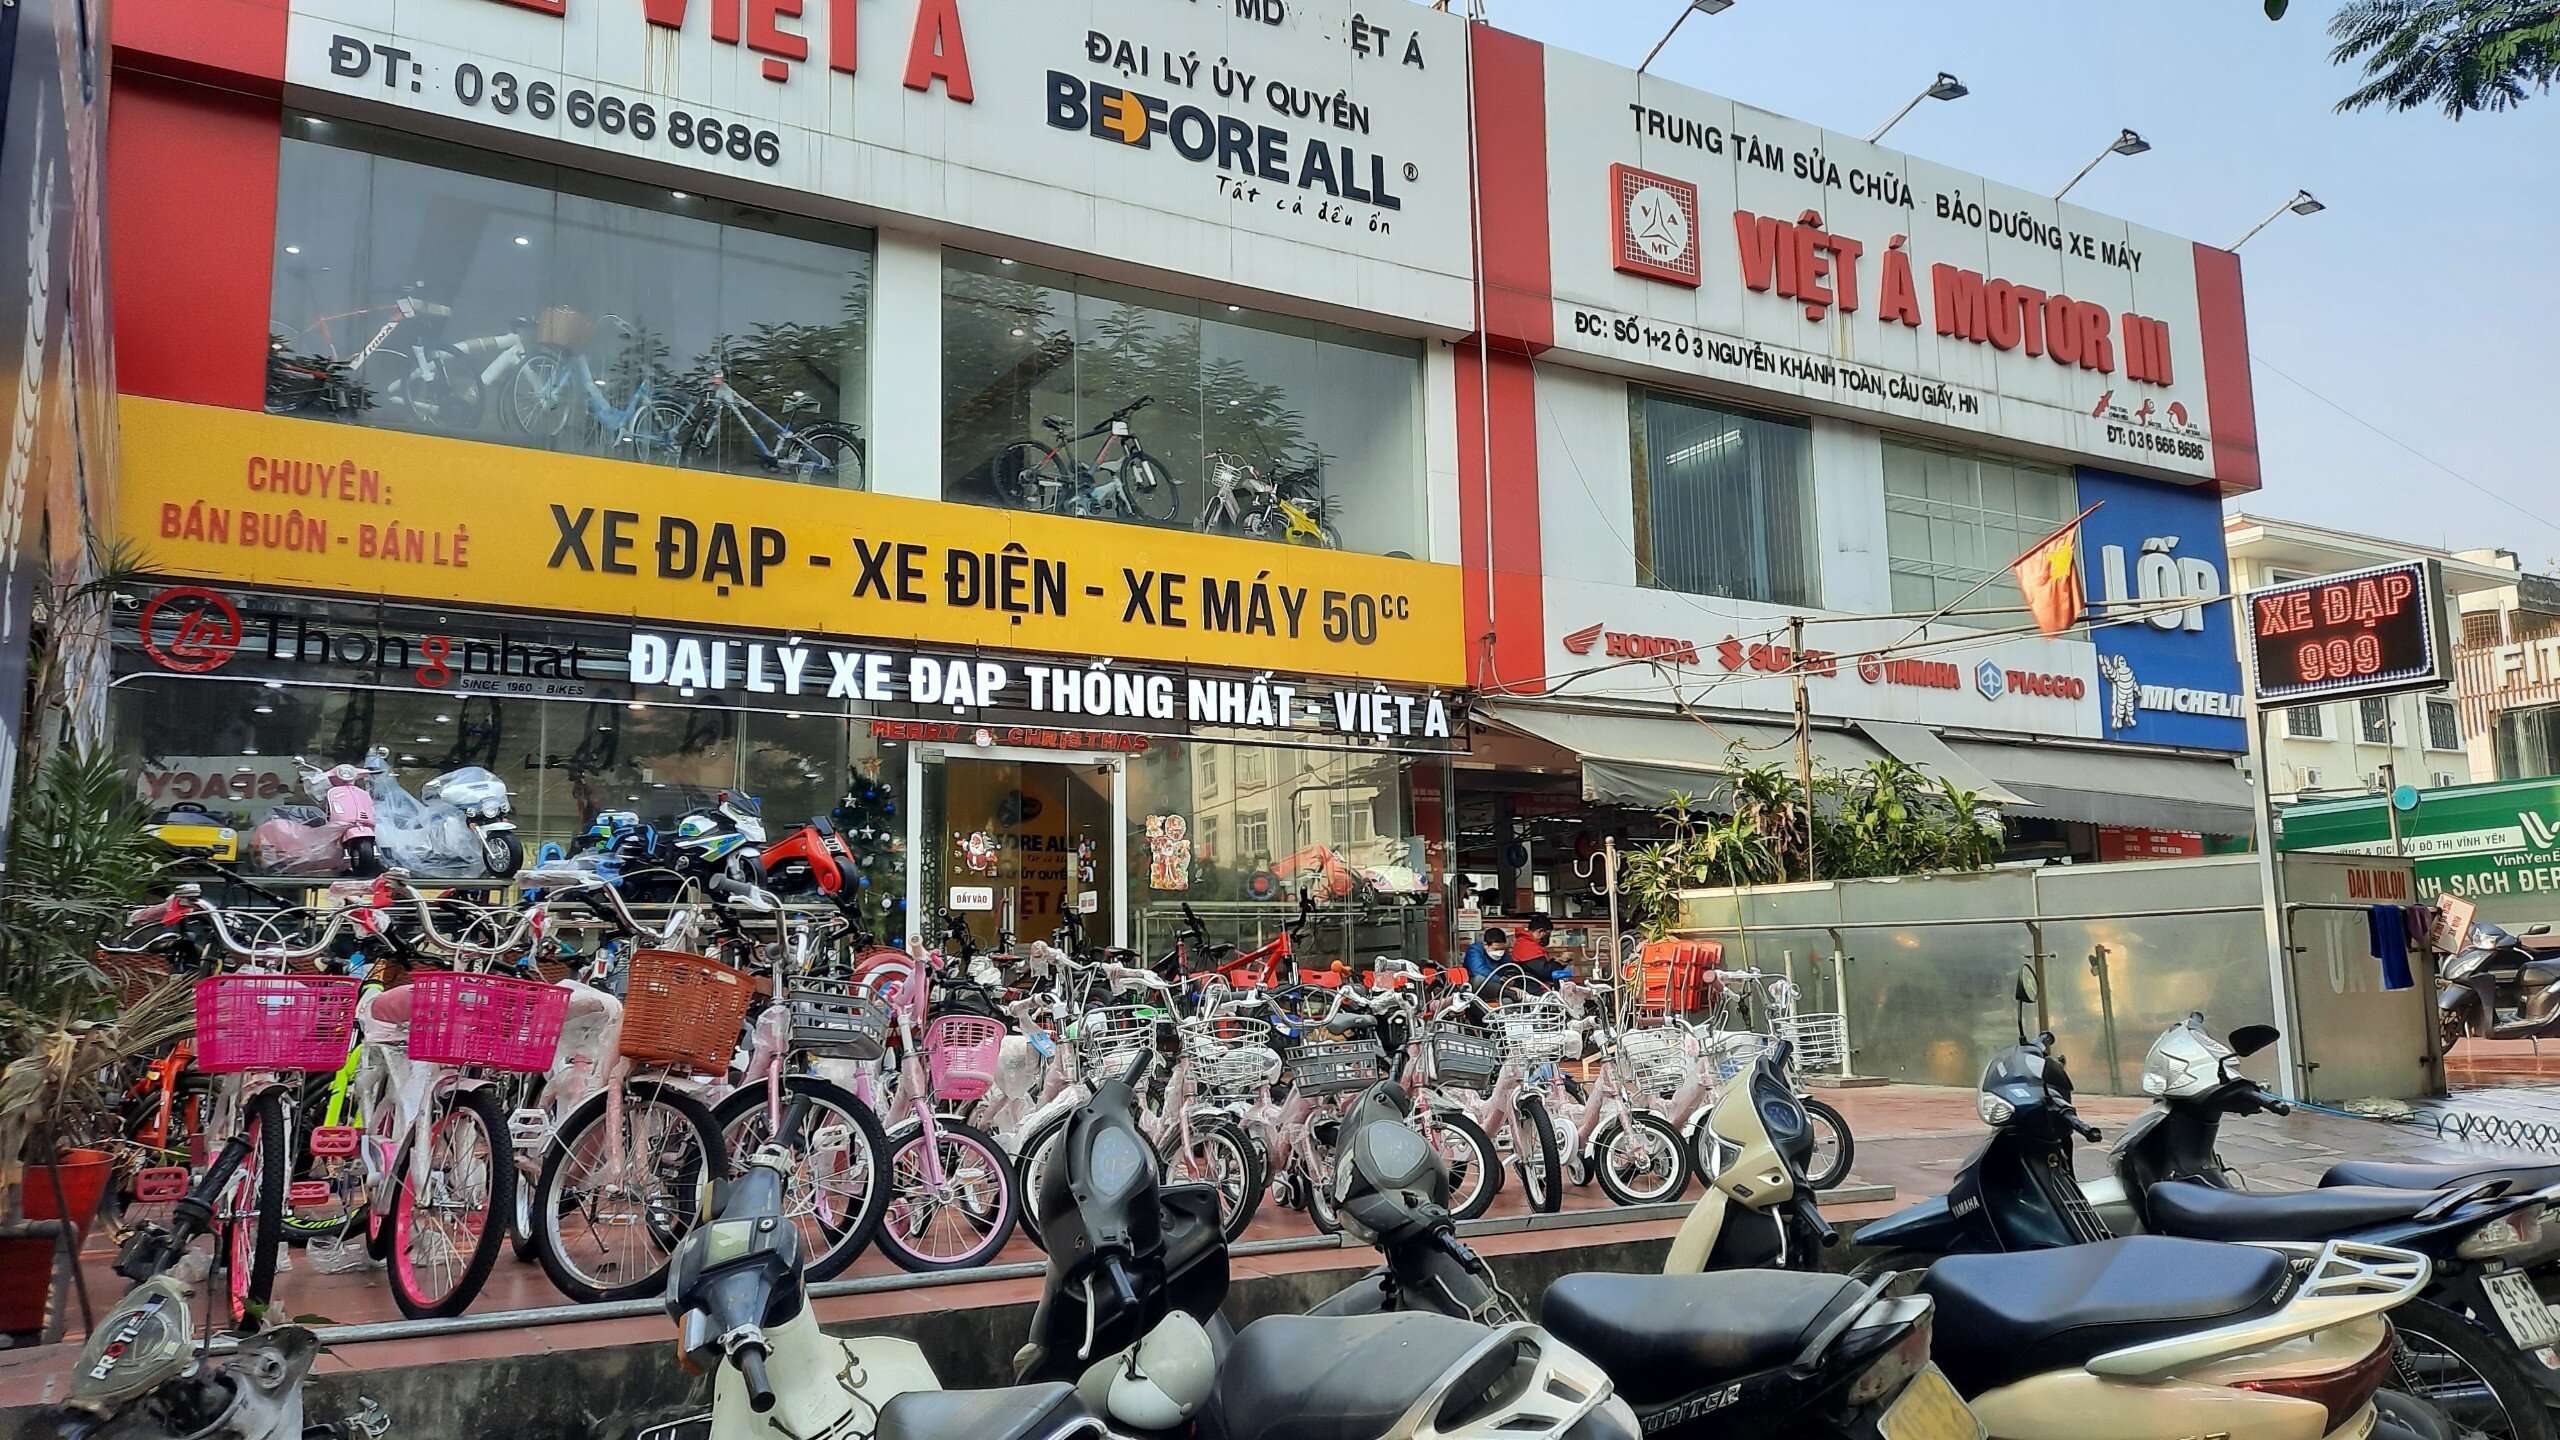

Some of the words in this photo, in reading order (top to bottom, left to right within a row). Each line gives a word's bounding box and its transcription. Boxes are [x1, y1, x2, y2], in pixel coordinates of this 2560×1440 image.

[1402, 31, 1425, 70] Á
[329, 34, 421, 93] ĐT:
[455, 62, 554, 120] 036
[567, 89, 656, 141] 666
[667, 110, 781, 168] 8686
[1085, 30, 1148, 78] ĐẠI
[1164, 51, 1200, 88] LÝ
[1212, 57, 1256, 103] ỦY
[1266, 81, 1370, 135] QUYỀN
[1046, 69, 1291, 185] BEFORE
[1297, 138, 1402, 211] ALL
[1216, 175, 1261, 203] Tất
[1318, 200, 1353, 228] đều
[1369, 211, 1391, 236] ổn
[1629, 103, 1724, 155] TRUNG
[1731, 132, 1785, 173] TÂM
[1793, 147, 1843, 190] SỬA
[1849, 169, 1916, 211] CHỮA
[1936, 189, 1983, 228] BẢO
[1988, 210, 2063, 252] DƯỠNG
[2068, 231, 2097, 261] XE
[2101, 241, 2142, 273] MÁY
[1733, 209, 1863, 322] VIỆT
[1879, 234, 1922, 327] Á
[1932, 262, 2115, 374] MOTOR
[2121, 312, 2174, 387] III
[1574, 311, 1608, 338] ĐC:
[1614, 314, 1640, 344] SỐ
[1643, 326, 1672, 352] 1+2
[1675, 328, 1690, 355] Ô
[1693, 337, 1704, 358] 3
[1707, 341, 1776, 375] NGUYỄN
[1779, 356, 1836, 387] KHÁNH
[1839, 367, 1887, 400] TOÀN,
[1889, 373, 1920, 403] CẦU
[1922, 382, 1957, 414] GIẤY,
[1958, 393, 1979, 415] HN
[2177, 439, 2205, 462] 8686
[246, 456, 393, 506] CHUYÊN:
[159, 499, 230, 544] BÁN
[239, 509, 327, 554] BUÔN
[358, 520, 424, 563] BÁN
[433, 523, 470, 568] LẺ
[547, 504, 639, 574] XE
[655, 515, 787, 597] ĐẠP
[852, 538, 928, 603] XE
[943, 542, 1067, 625] ĐIỆN
[1121, 568, 1188, 628] XE
[1202, 570, 1308, 639] MÁY
[2102, 536, 2221, 632] LỐP
[2257, 591, 2315, 636] XE
[2321, 574, 2413, 628] ĐẠP
[1604, 631, 1700, 664] HONDA
[2298, 634, 2382, 683] 999
[461, 679, 500, 691] SINCE
[506, 682, 533, 693] 1960
[546, 684, 586, 696] BIKES
[628, 633, 726, 698] ĐẠI
[747, 637, 809, 695] LÝ
[826, 651, 894, 702] XE
[908, 658, 1007, 715] ĐẠP
[1023, 657, 1175, 721] THỐNG
[1187, 671, 1297, 728] NHẤT
[1333, 685, 1415, 743] VIỆT
[1424, 690, 1450, 738] Á
[1884, 658, 1962, 690] YAMAHA
[2006, 670, 2086, 700] PIAGGIO
[870, 721, 961, 742] MERRY
[1007, 727, 1151, 752] CHRISTMAS
[2436, 838, 2454, 851] THỊ
[2456, 835, 2482, 848] VĨNH
[2485, 832, 2507, 845] YÊN
[2373, 870, 2407, 900] NILON
[2451, 870, 2511, 900] SẠCH
[1951, 1195, 1981, 1219] YAMAHA
[2270, 1272, 2294, 1306] HONDA
[2510, 1306, 2556, 1340] 6119
